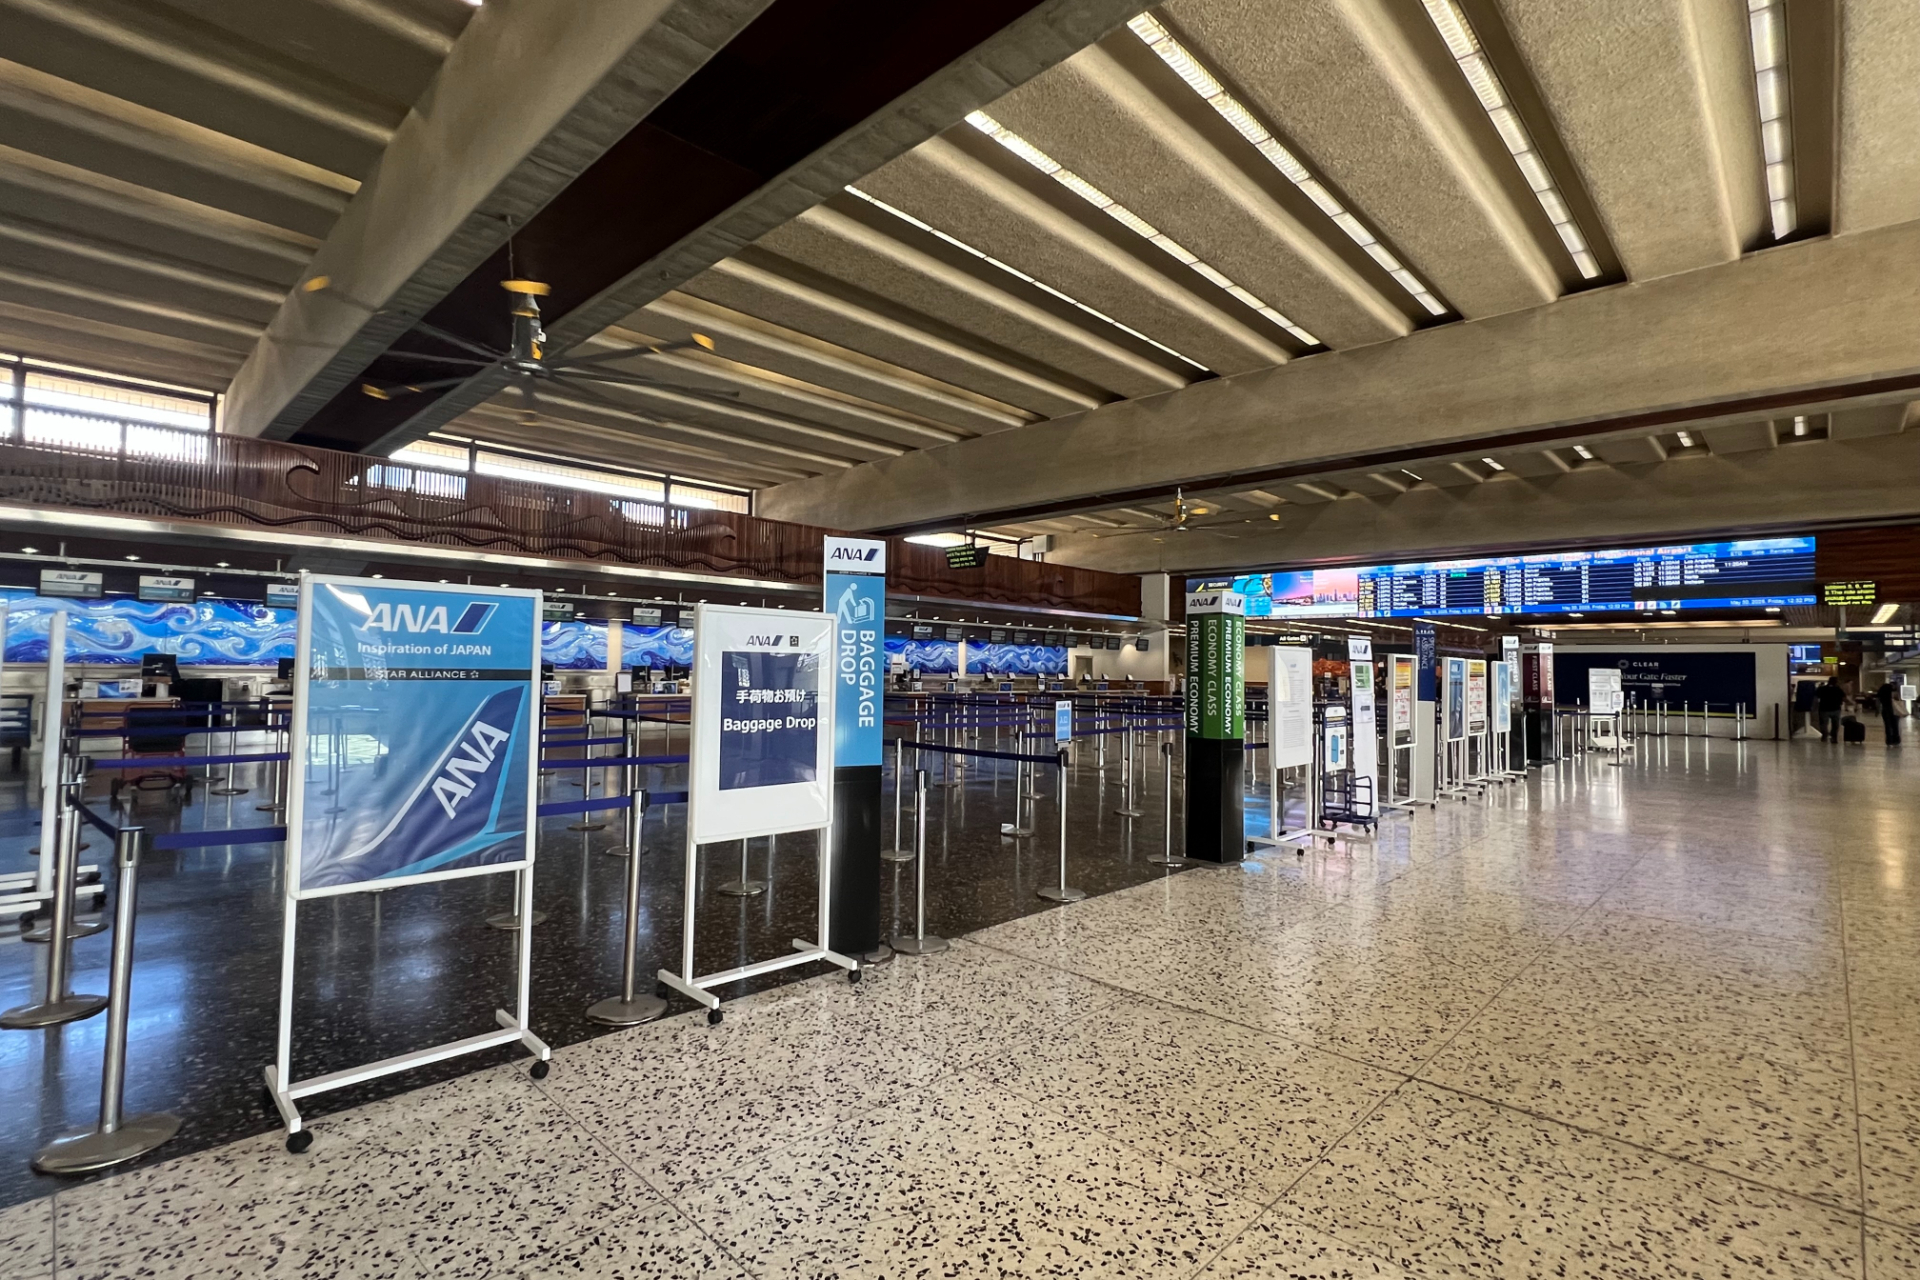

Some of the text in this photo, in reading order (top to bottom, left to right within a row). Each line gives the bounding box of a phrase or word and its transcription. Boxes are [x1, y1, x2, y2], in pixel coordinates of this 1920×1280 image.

[830, 547, 863, 561] ANA
[1657, 546, 1692, 556] Airport
[1189, 598, 1210, 608] ANA
[1225, 597, 1238, 607] ANA
[360, 602, 448, 634] ANA
[746, 635, 772, 647] ANA
[357, 642, 492, 656] Inspiration of JAPAN
[841, 630, 856, 685] DROP
[375, 669, 467, 679] STAR ALLIANCE
[1207, 619, 1217, 716] ECONOMY CLASS
[858, 630, 875, 728] BAGGAGE
[1189, 620, 1199, 734] PREMIUM ECONOMY
[1639, 672, 1659, 680] Gate
[1660, 672, 1688, 681] Faster
[736, 689, 807, 704] 手荷物お預け
[1224, 674, 1232, 735] ECONOMY
[723, 717, 816, 733] Baggage Drop
[431, 720, 510, 820] ANA
